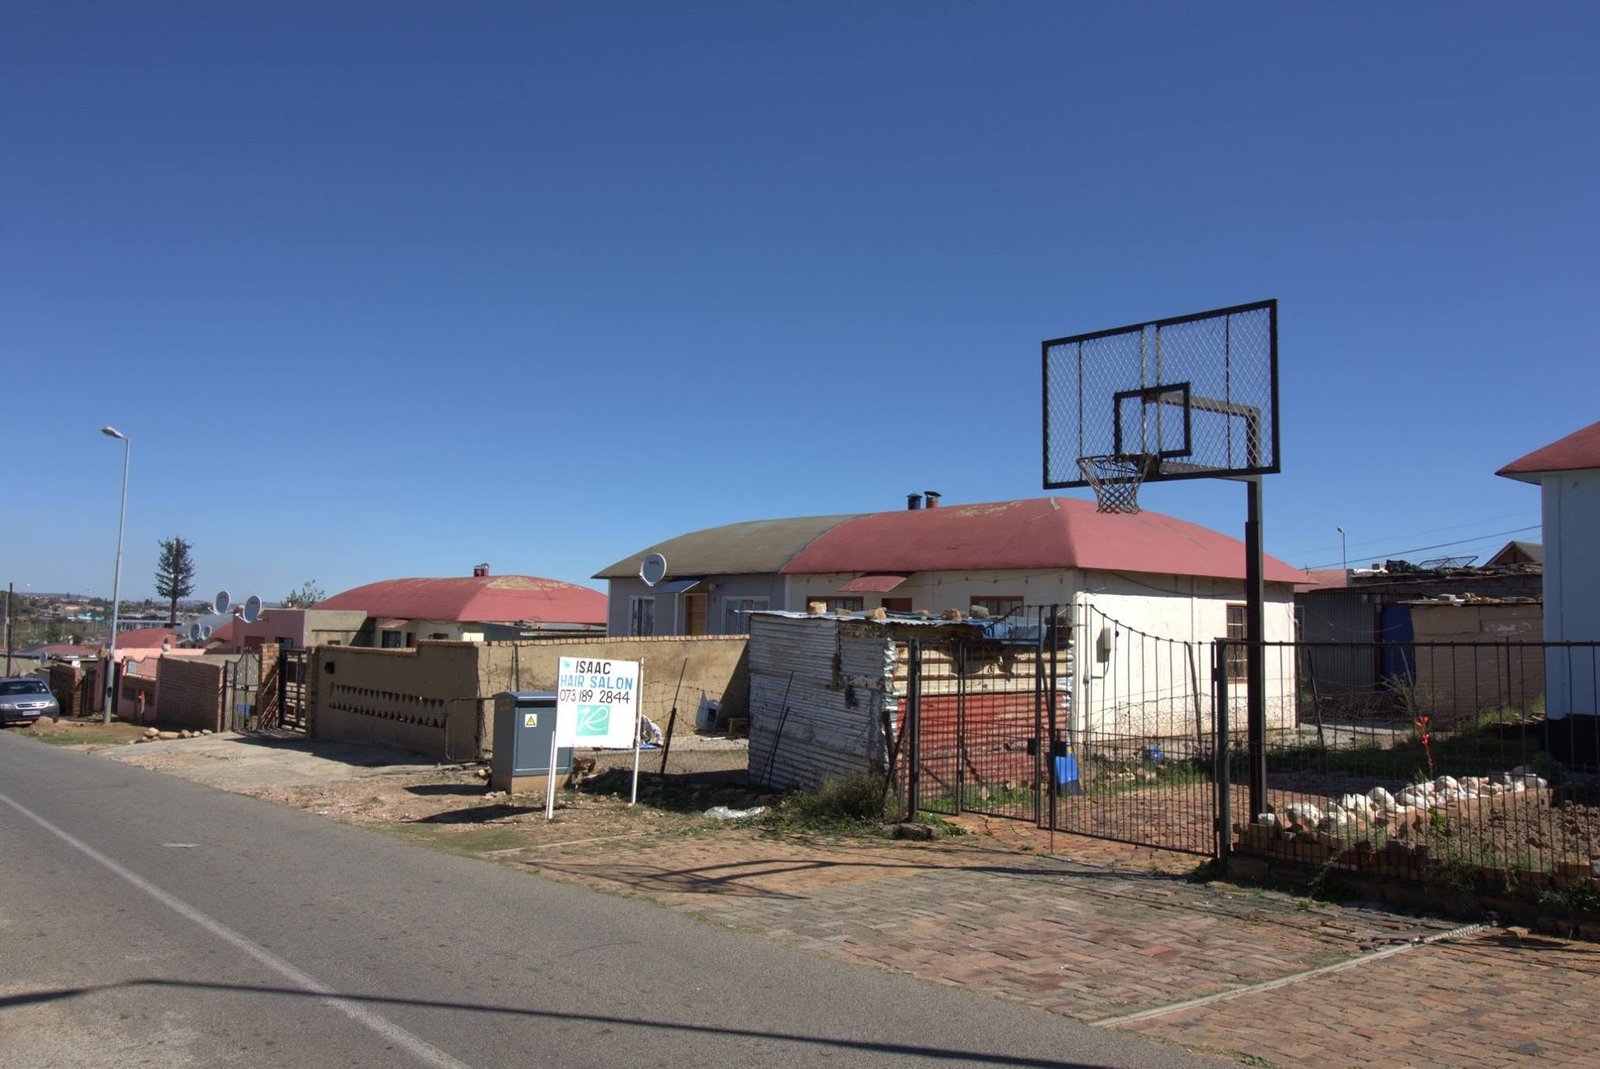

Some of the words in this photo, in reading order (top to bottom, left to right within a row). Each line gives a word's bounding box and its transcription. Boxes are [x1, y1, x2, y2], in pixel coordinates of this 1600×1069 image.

[576, 660, 611, 675] ISAAC
[560, 674, 585, 687] HAIR
[590, 676, 633, 690] SALON
[560, 689, 577, 702] 073
[579, 689, 593, 702] 189
[599, 690, 630, 704] 2844
